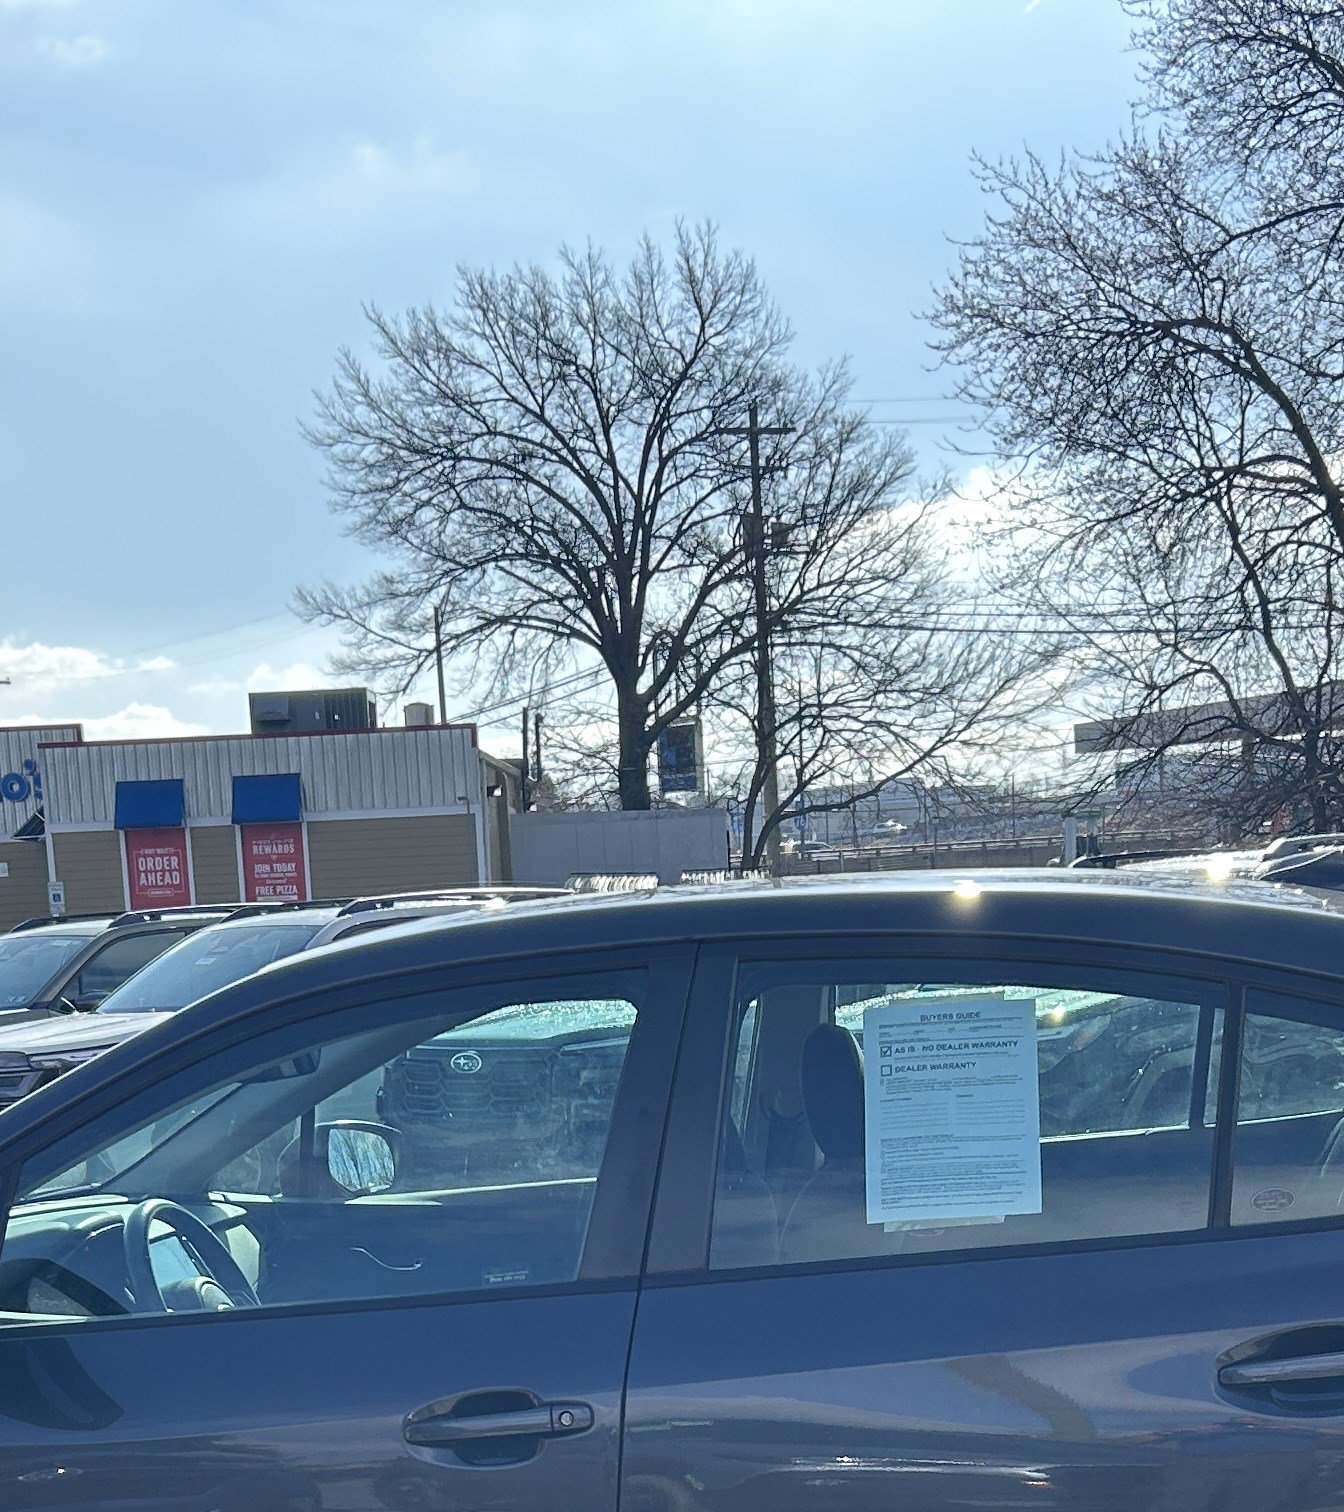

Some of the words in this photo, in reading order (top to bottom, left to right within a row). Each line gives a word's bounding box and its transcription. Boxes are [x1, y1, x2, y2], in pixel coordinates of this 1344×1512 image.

[252, 843, 295, 855] REWARDS
[138, 856, 180, 871] ORDER
[273, 862, 296, 873] TODAY
[139, 870, 181, 886] AHEAD
[256, 886, 274, 896] FREE
[276, 884, 299, 895] PIZZA
[920, 1013, 954, 1022] BUYERS
[956, 1011, 982, 1019] GUIDE
[894, 1047, 906, 1055] AS
[921, 1044, 934, 1052] NO
[936, 1042, 970, 1051] DEALER
[972, 1040, 1018, 1049] WARRANTY
[895, 1064, 928, 1073] DEALER
[930, 1061, 977, 1070] WARRANTY
